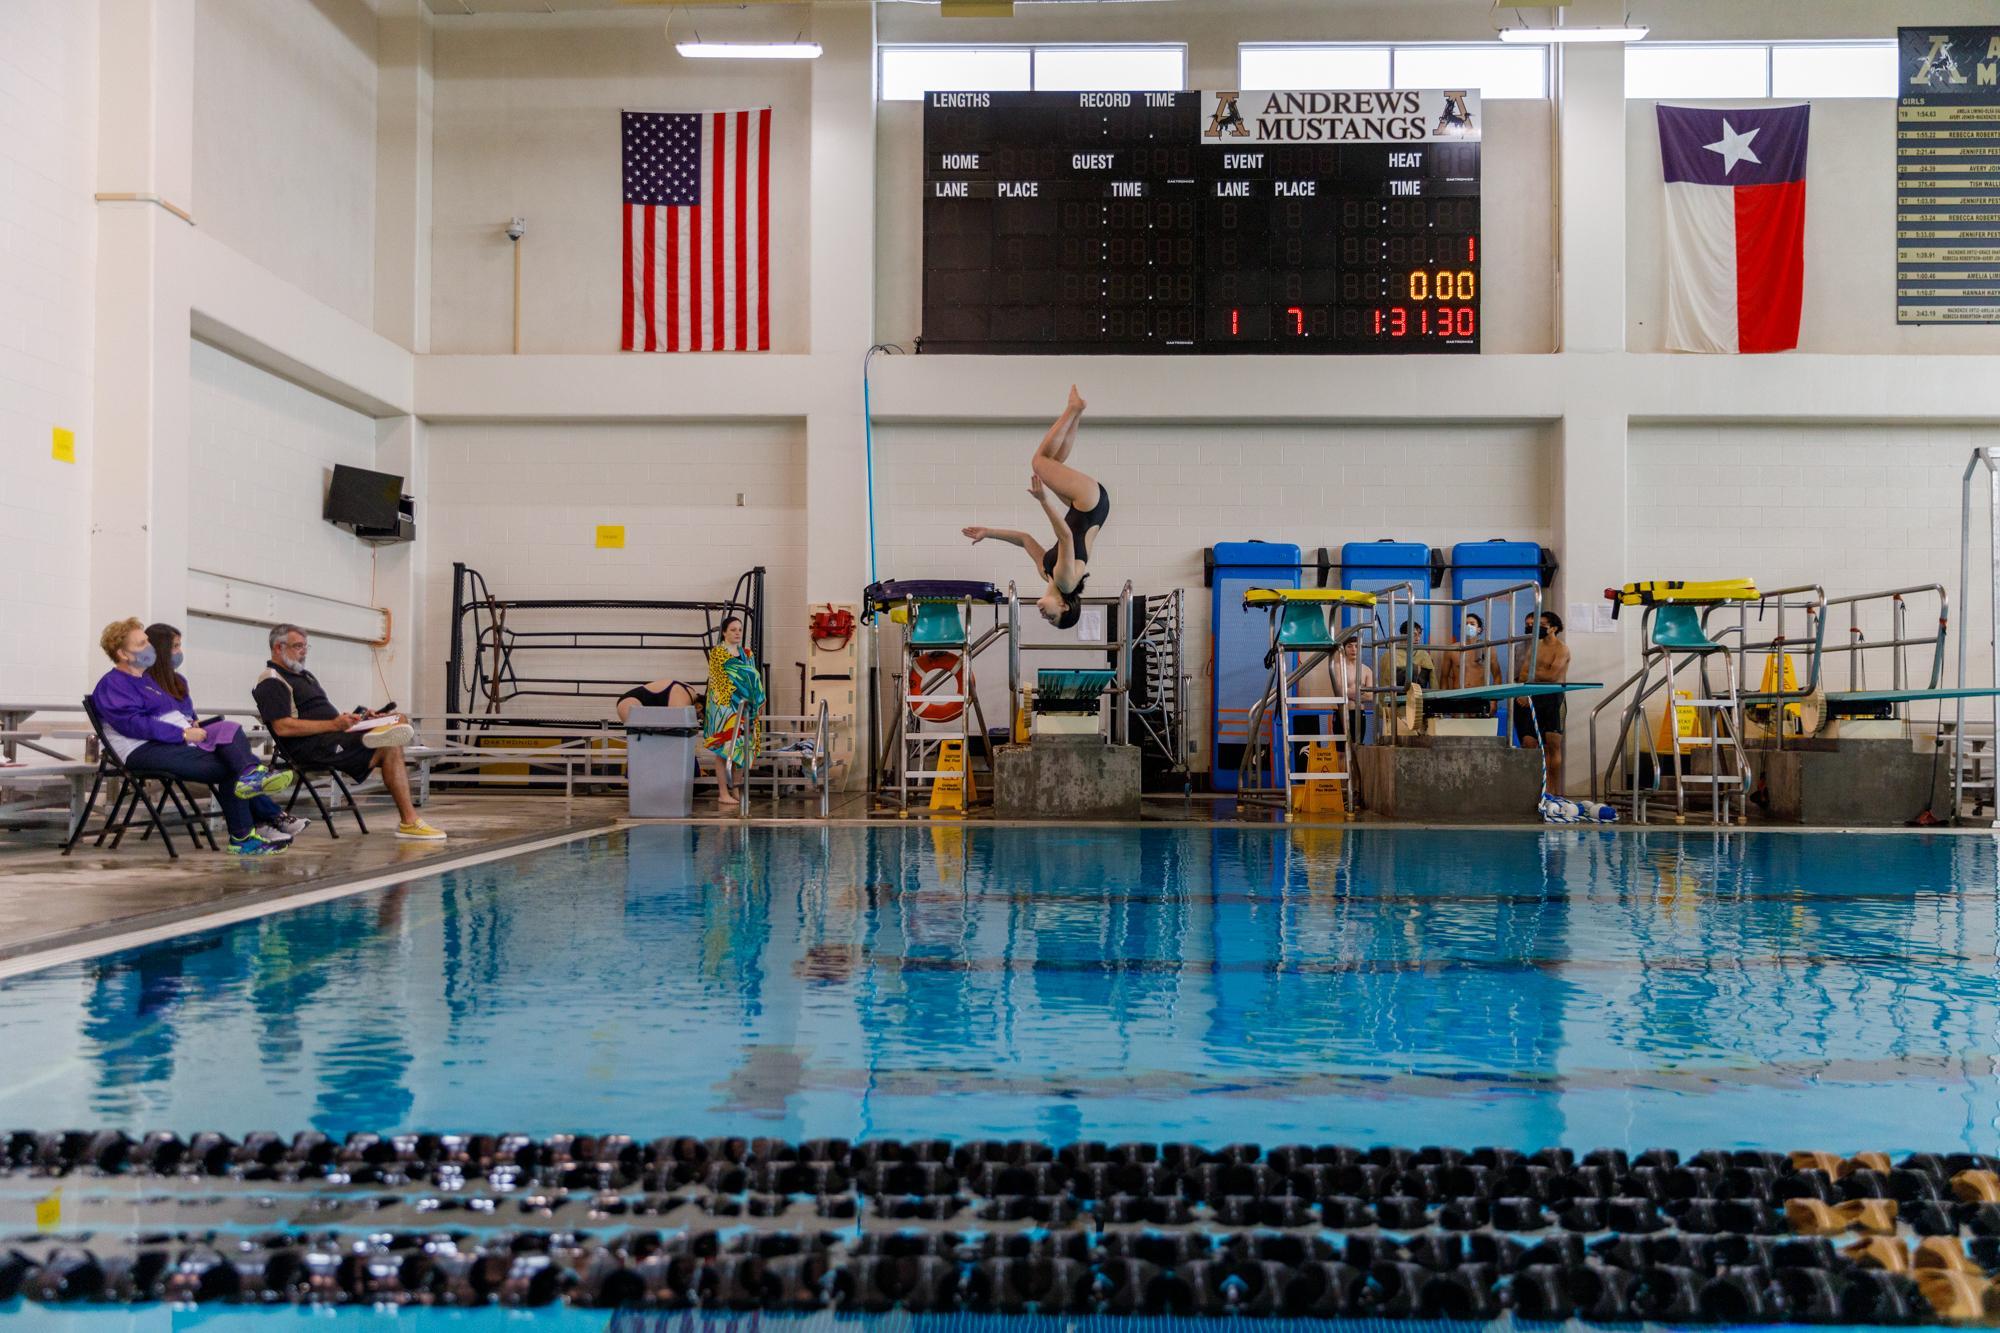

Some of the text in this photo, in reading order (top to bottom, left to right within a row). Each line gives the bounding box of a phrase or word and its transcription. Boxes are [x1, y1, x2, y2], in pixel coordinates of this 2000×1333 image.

[933, 93, 990, 108] LENGTHS
[1080, 93, 1175, 107] RECORD TIME
[1262, 91, 1420, 115] ANDREWS
[1256, 116, 1426, 141] MUSTANGS
[942, 154, 979, 169] HOME
[1072, 154, 1114, 169] GUEST
[1224, 154, 1264, 168] EVENT
[1388, 153, 1422, 167] HEAT
[936, 182, 1142, 197] LANE PLACE TIME
[1217, 180, 1421, 196] LANE PLACE TIME
[1468, 237, 1474, 262] 1
[1410, 271, 1474, 300] 0.00
[1232, 310, 1238, 335] 1
[1375, 308, 1474, 336] 1:31.30
